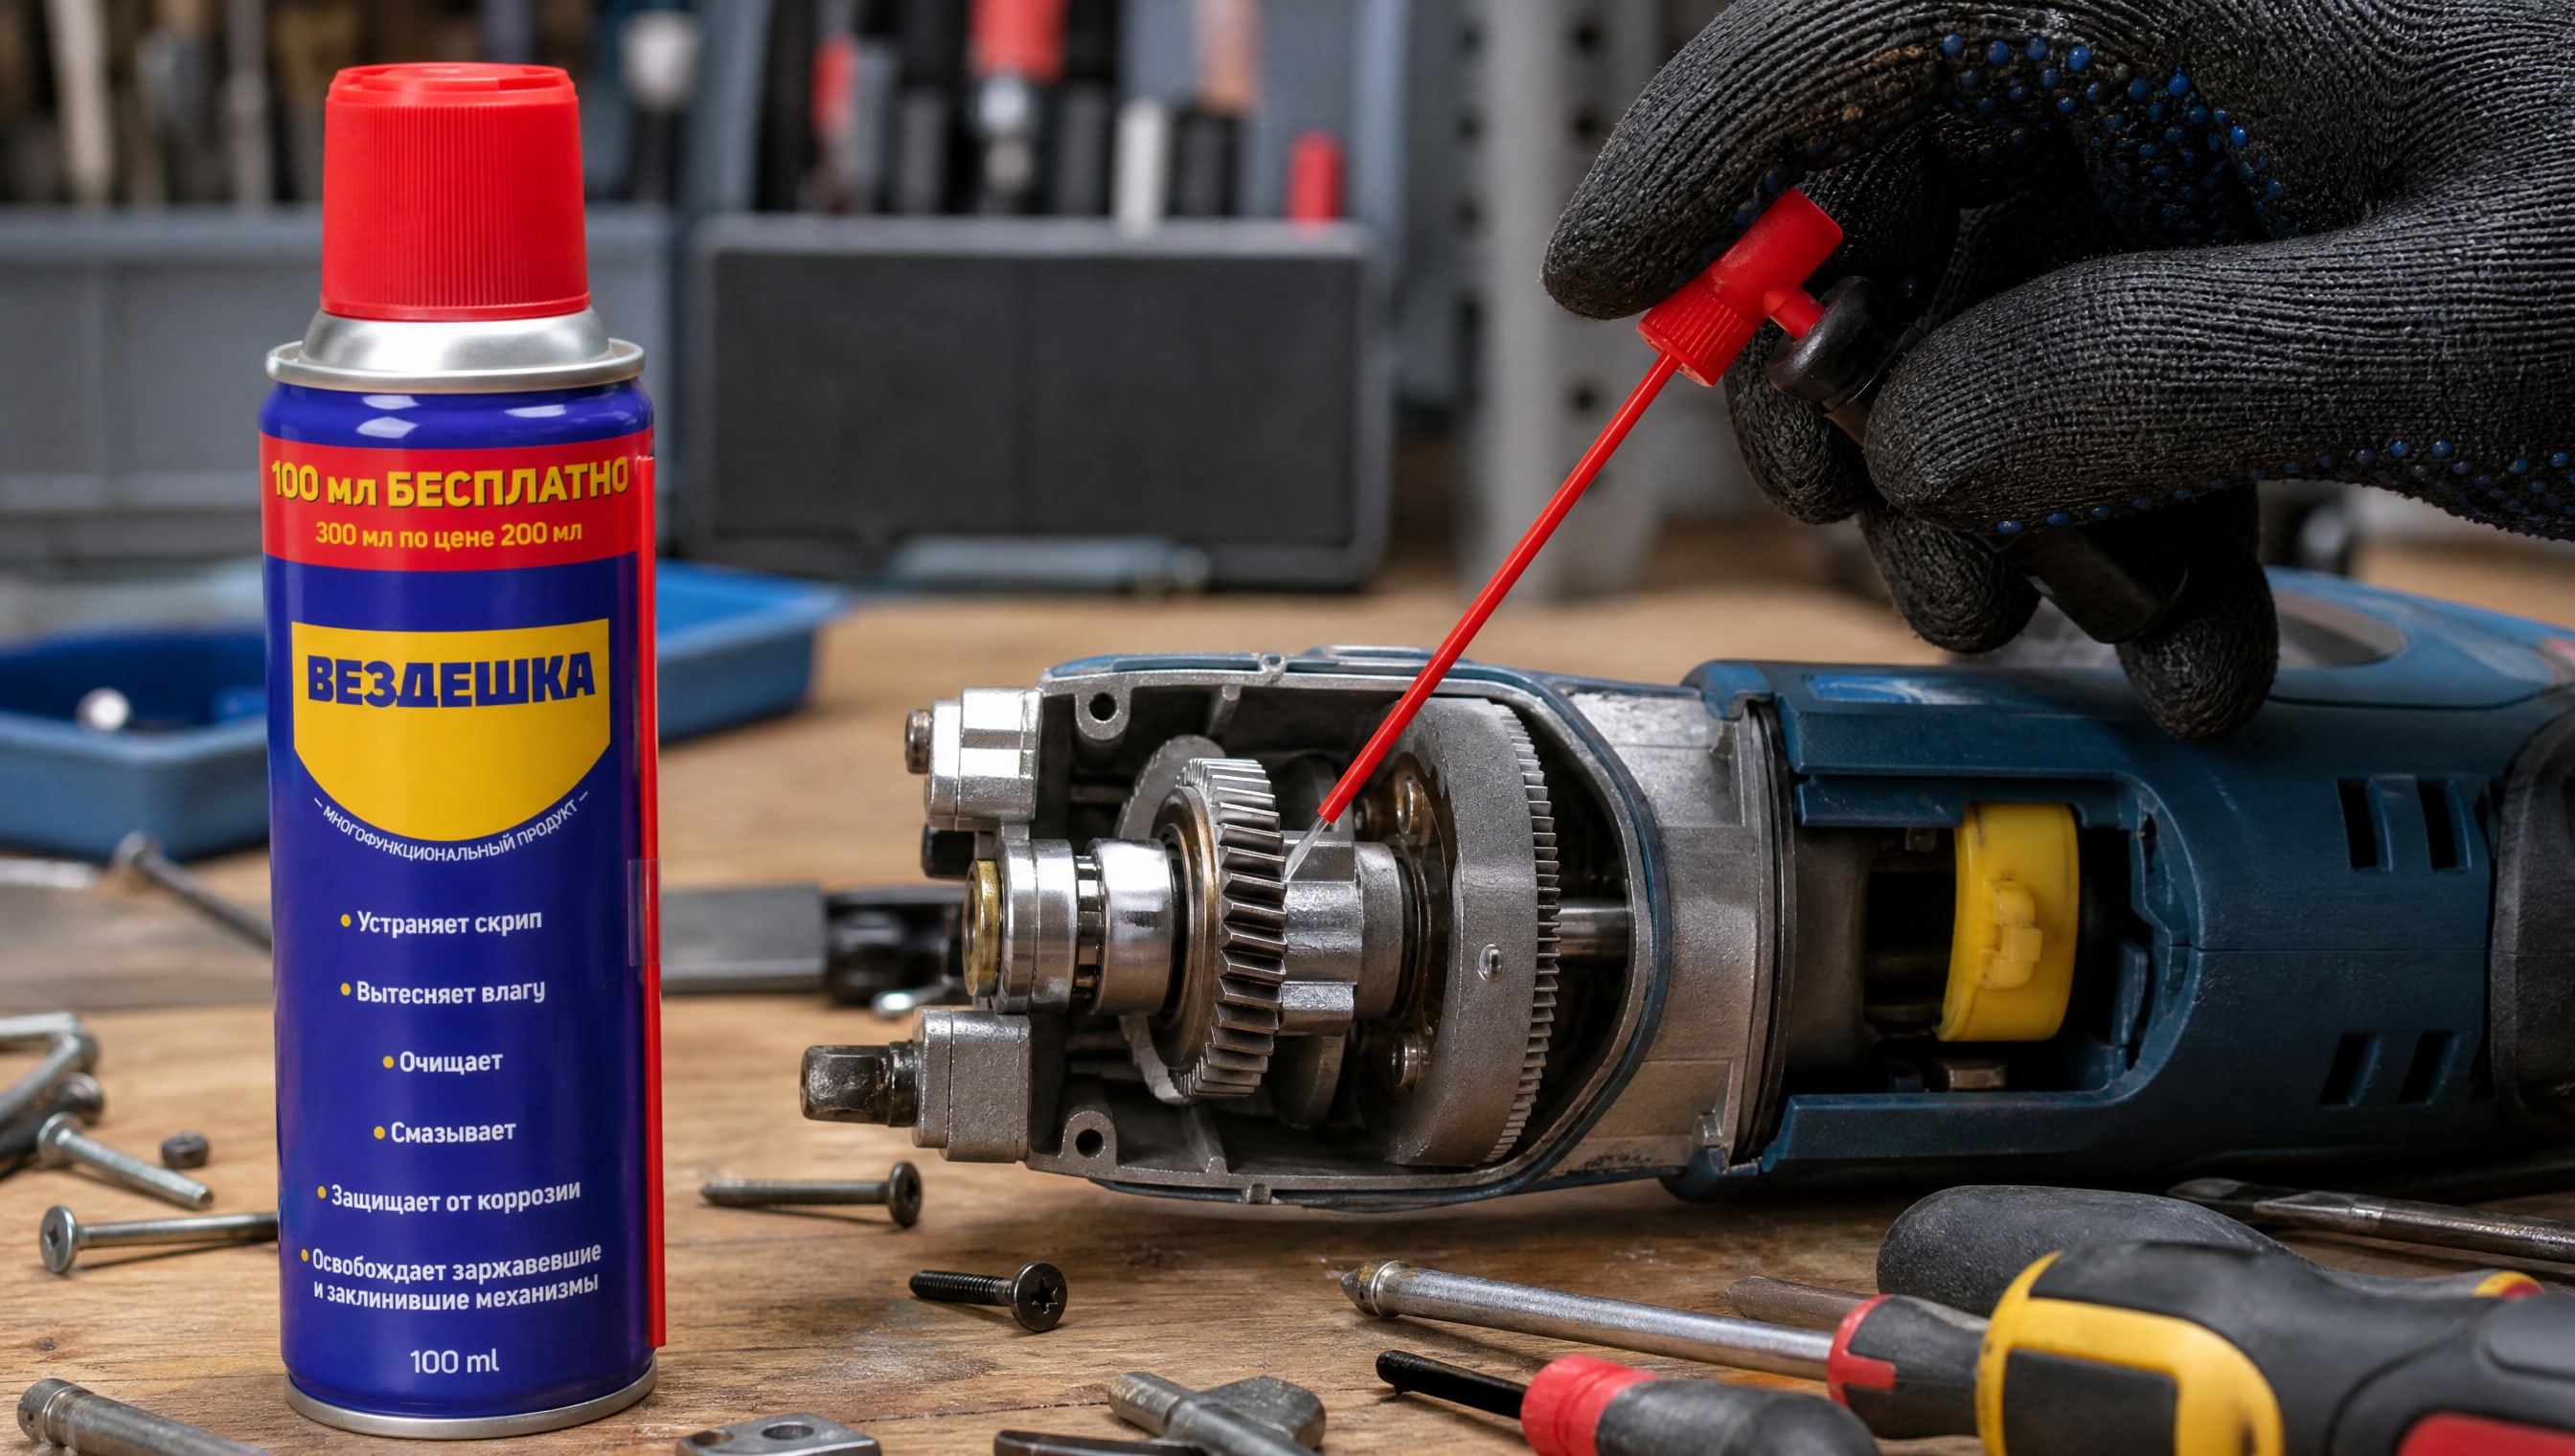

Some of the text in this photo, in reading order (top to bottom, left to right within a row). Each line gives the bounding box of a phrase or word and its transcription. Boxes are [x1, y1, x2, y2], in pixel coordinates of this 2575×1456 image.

[271, 457, 628, 509] 100 мл БЕСПЛАТНО
[315, 520, 581, 552] 300 мл по цене 200 мл
[308, 651, 596, 708] ВЕЗДЕШКА
[322, 799, 578, 862] МНОГОФУНКЦИОНАЛЬНЫЙ ПРОДУКТ
[356, 910, 542, 939] Устраняет скрип
[356, 980, 545, 1004] Вытесняет влагу
[399, 1051, 503, 1076] Очищает
[391, 1121, 516, 1144] Смазывает
[331, 1181, 581, 1215] Защищает от коррозии
[312, 1244, 602, 1284] Освобождает заржавевшие
[313, 1273, 598, 1310] и заклинившие механизмы
[409, 1348, 500, 1375] 100 ml
